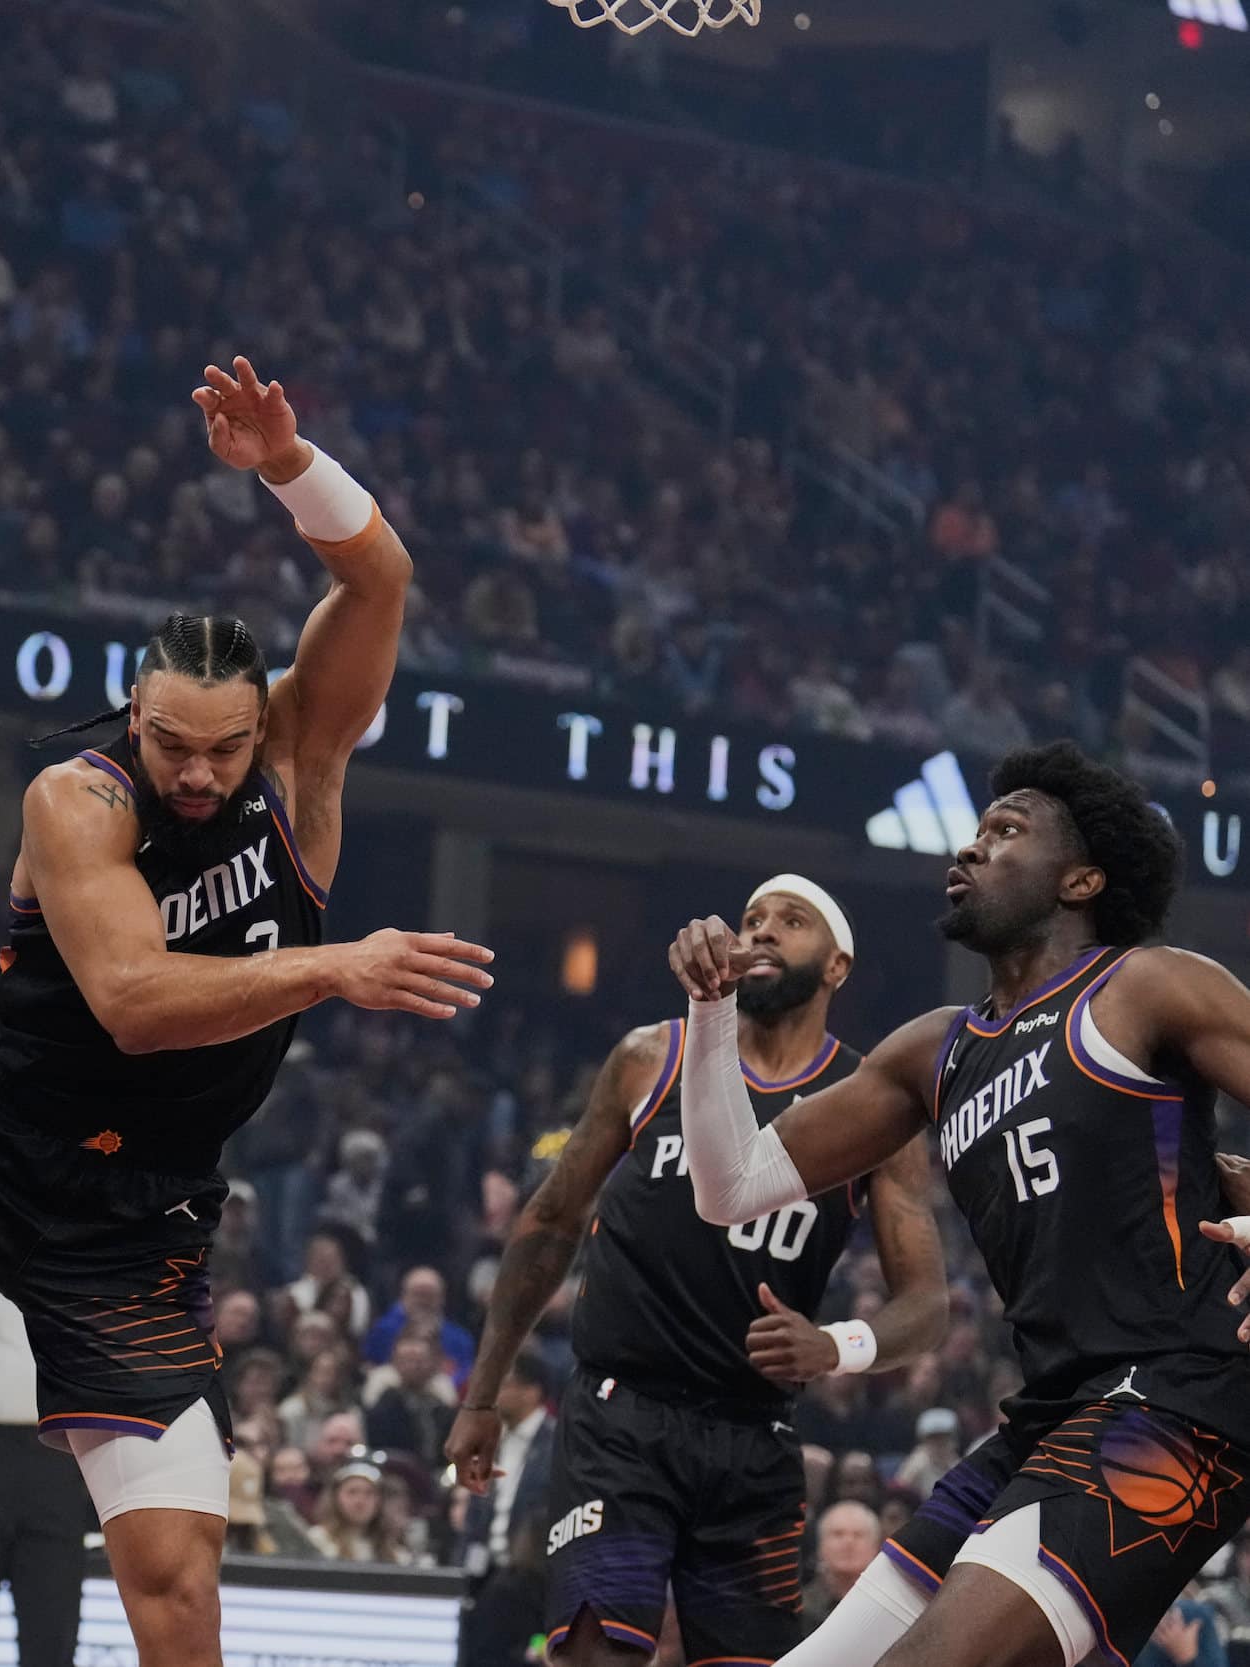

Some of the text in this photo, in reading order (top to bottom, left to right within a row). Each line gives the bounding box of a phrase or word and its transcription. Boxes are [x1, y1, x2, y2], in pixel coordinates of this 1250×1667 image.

[556, 711, 797, 811] THIS
[160, 835, 276, 942] OENIX
[1014, 1011, 1060, 1036] PayPal
[939, 1040, 1052, 1172] PHOENIX
[1002, 1116, 1061, 1203] 15
